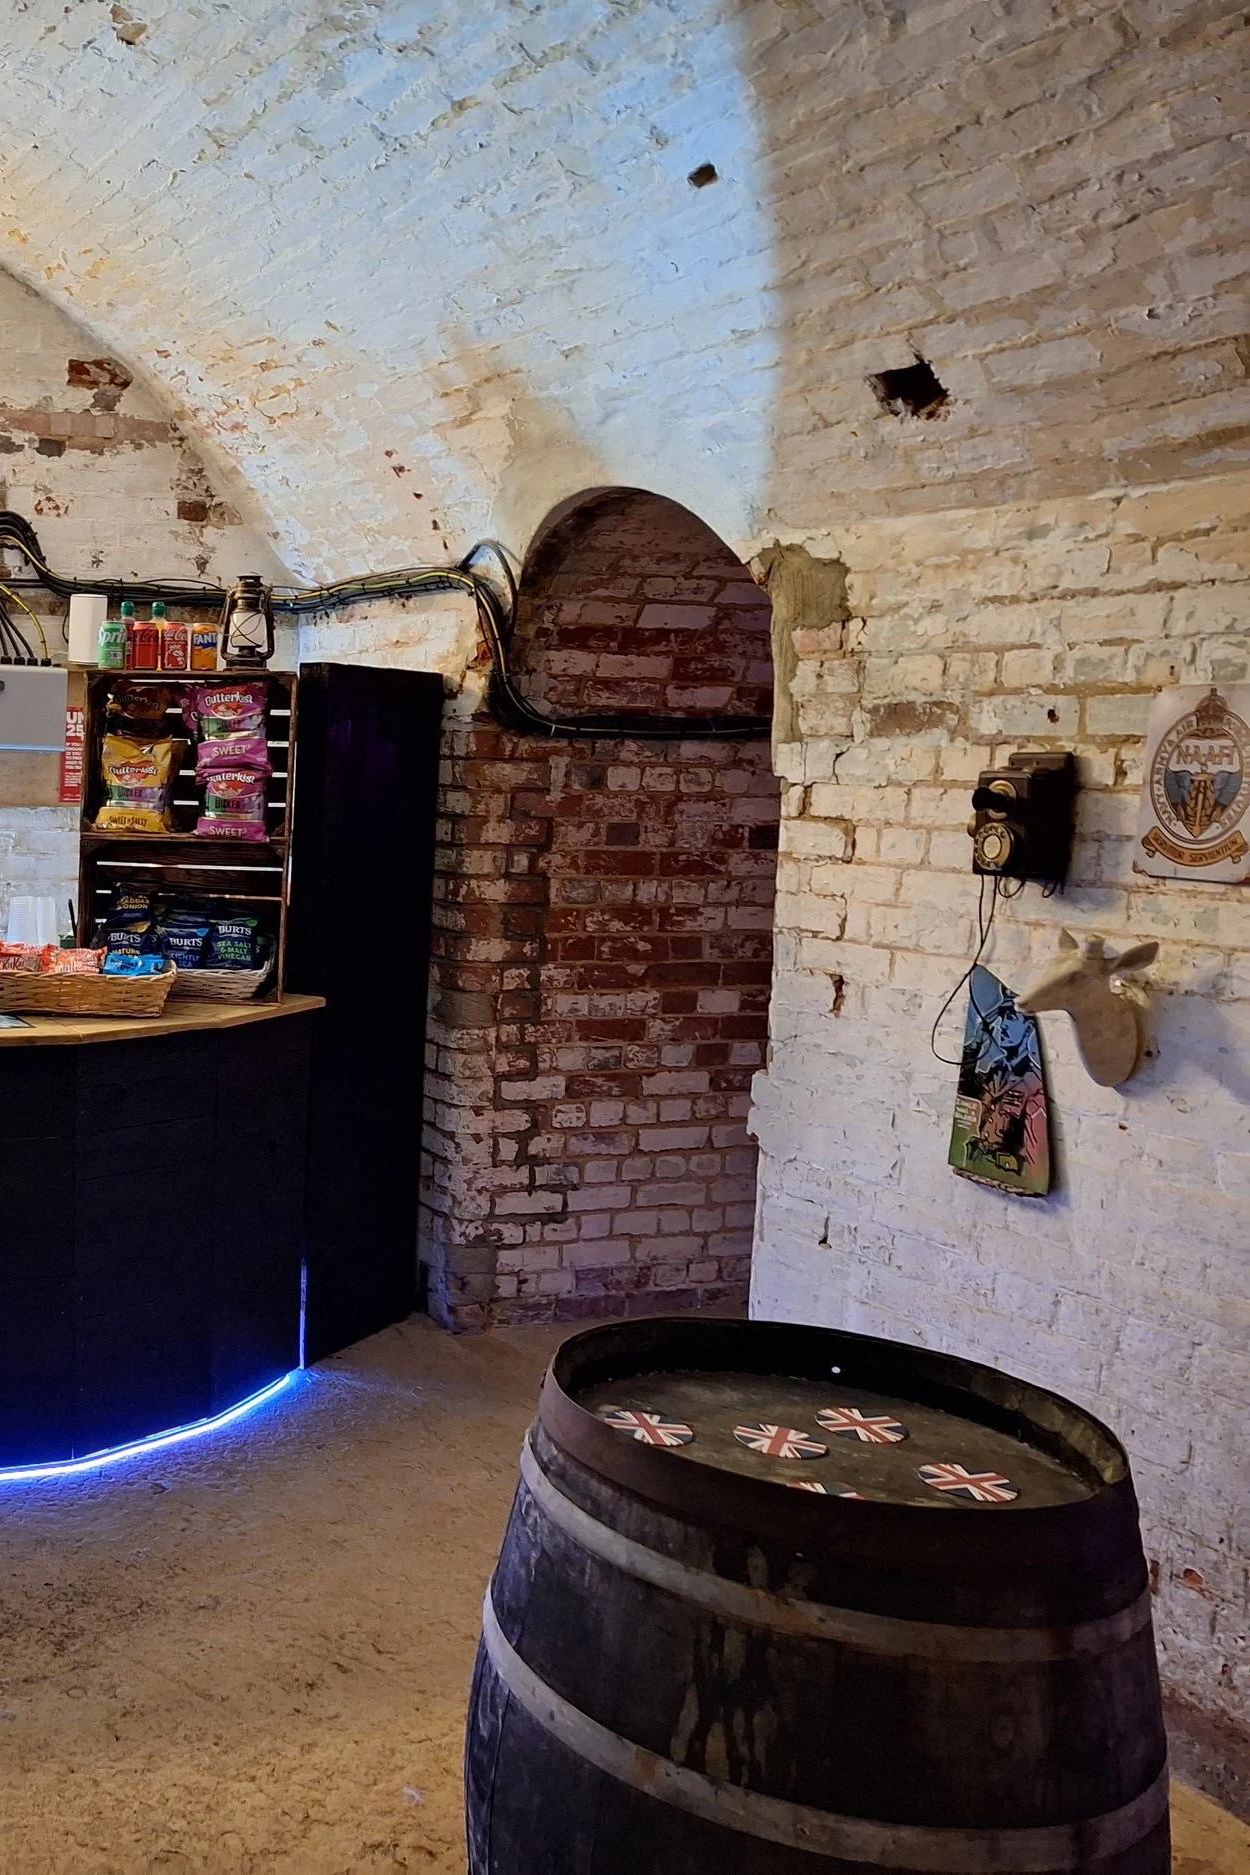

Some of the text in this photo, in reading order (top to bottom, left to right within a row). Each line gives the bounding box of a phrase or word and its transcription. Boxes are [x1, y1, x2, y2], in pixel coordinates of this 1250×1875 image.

[212, 745, 247, 757] SWEET
[209, 826, 244, 837] SWEET
[218, 925, 251, 935] BURTS
[169, 937, 203, 947] BURTS
[233, 941, 251, 949] SALT
[227, 947, 248, 955] MALT
[217, 952, 251, 961] VINEGAR
